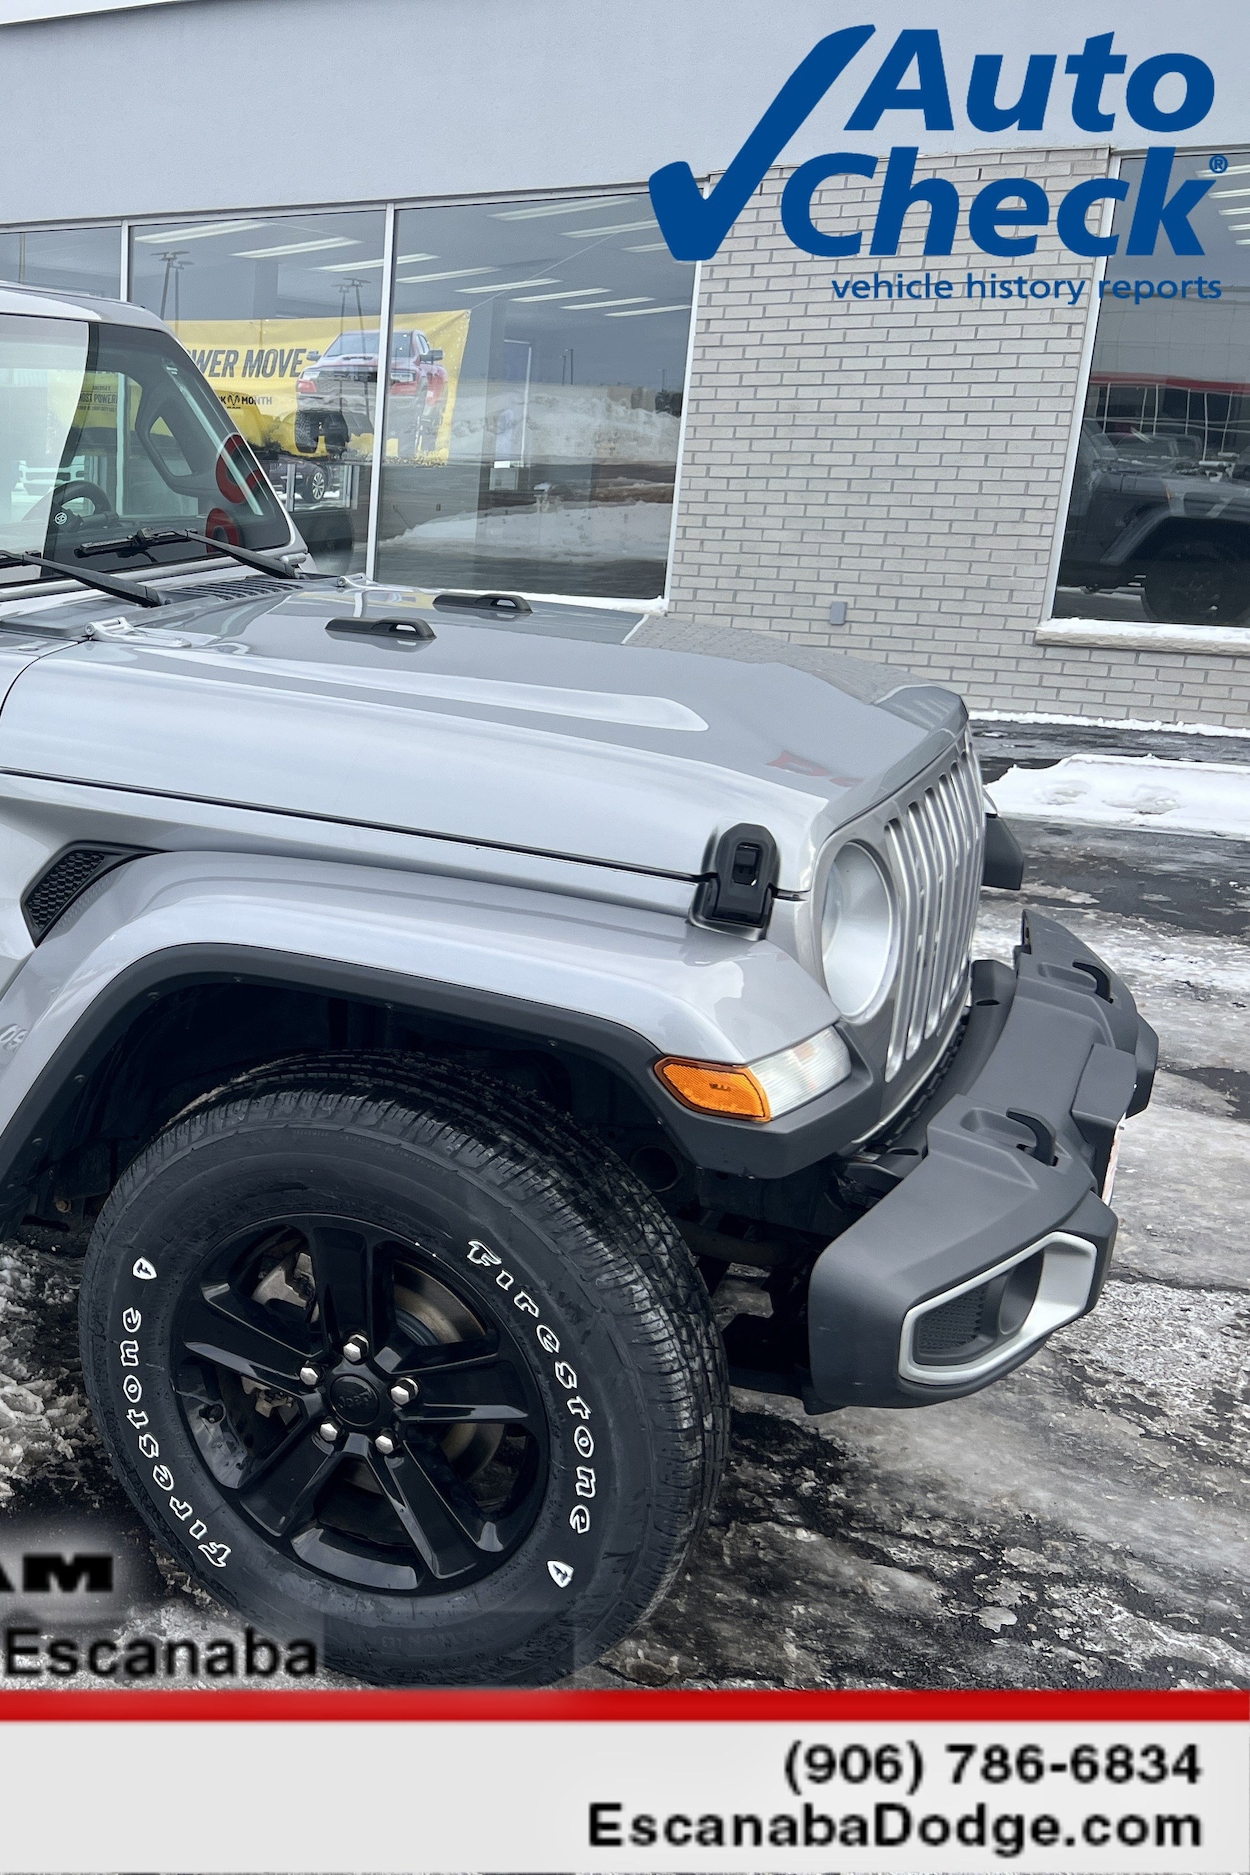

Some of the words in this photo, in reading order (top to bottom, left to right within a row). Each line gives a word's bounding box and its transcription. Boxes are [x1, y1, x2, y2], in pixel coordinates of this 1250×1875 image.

[241, 348, 306, 378] MOVE
[241, 396, 273, 405] MONTH
[119, 1306, 232, 1568] Firestone
[467, 1240, 597, 1534] Firestone
